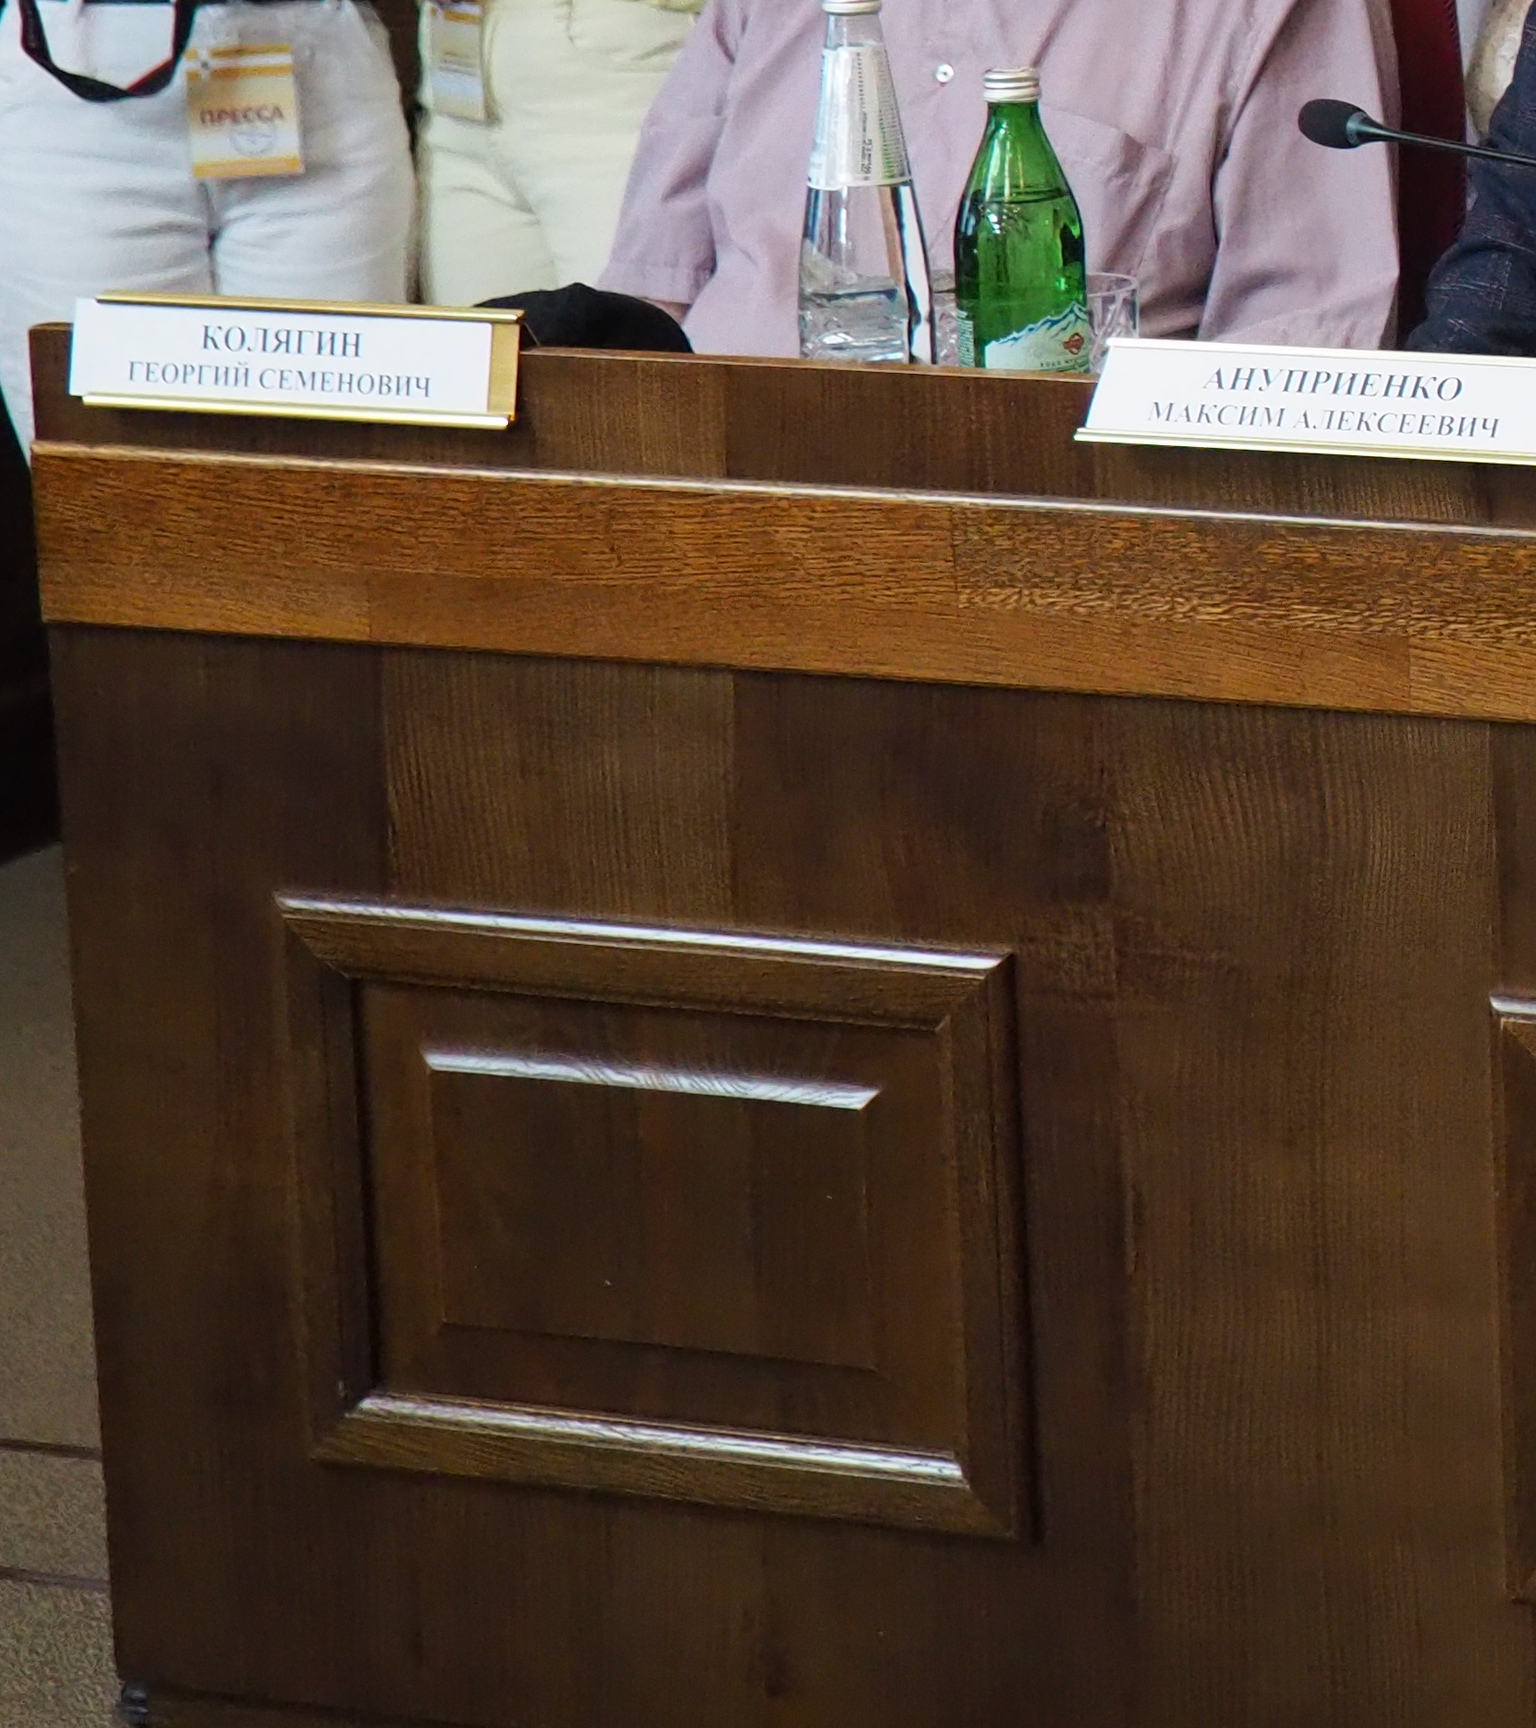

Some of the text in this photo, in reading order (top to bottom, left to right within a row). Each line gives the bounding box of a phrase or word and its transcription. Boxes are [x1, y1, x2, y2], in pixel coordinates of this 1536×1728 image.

[200, 104, 284, 125] ПРЕССА
[201, 324, 362, 358] КОЛЯГИН
[129, 360, 431, 399] ГЕОРГИЙ СЕМЕНОВИЧ
[1202, 367, 1463, 402] АНУПРИЕНКО
[1148, 401, 1500, 439] МАКСИМ АЛЕКСЕЕВИЧ
